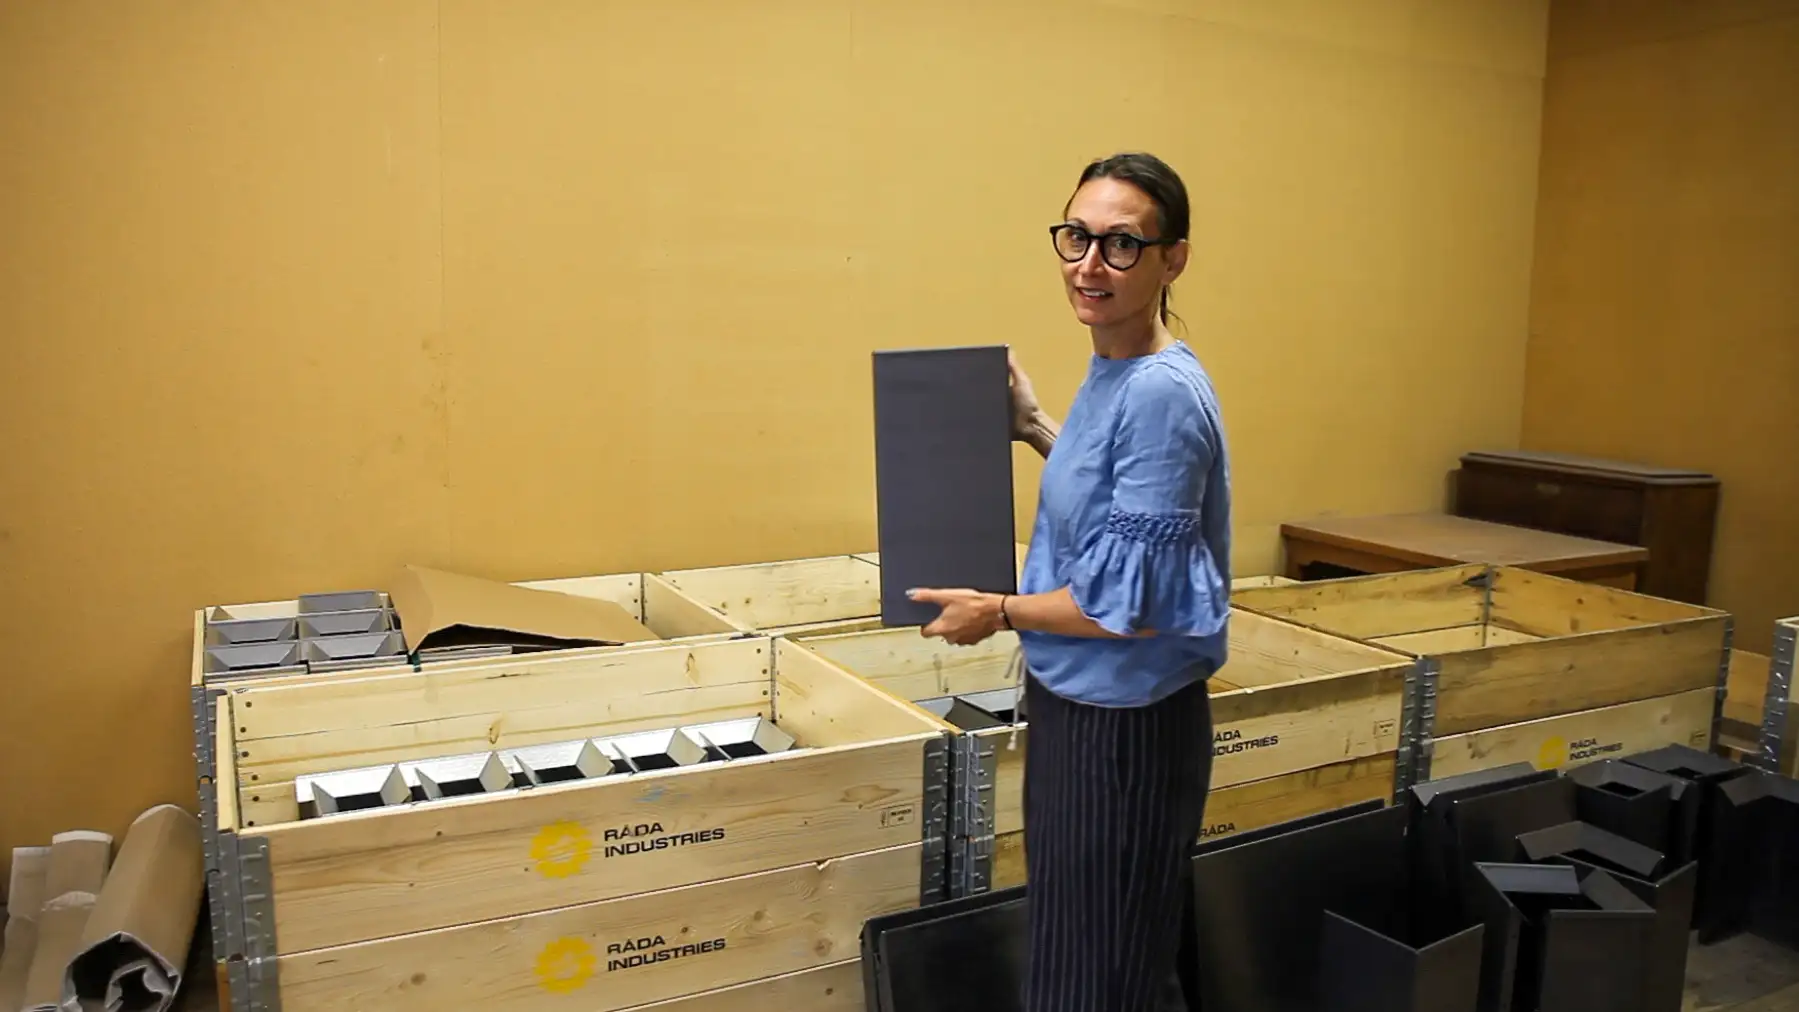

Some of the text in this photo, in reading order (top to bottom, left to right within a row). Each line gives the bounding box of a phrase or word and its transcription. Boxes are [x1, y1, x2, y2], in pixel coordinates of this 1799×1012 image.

[1212, 735, 1279, 756] DUSTRIES
[1570, 743, 1623, 761] INDUSTRIES
[605, 828, 725, 858] INDUSTRIES
[608, 938, 726, 972] INDUSTRIES
